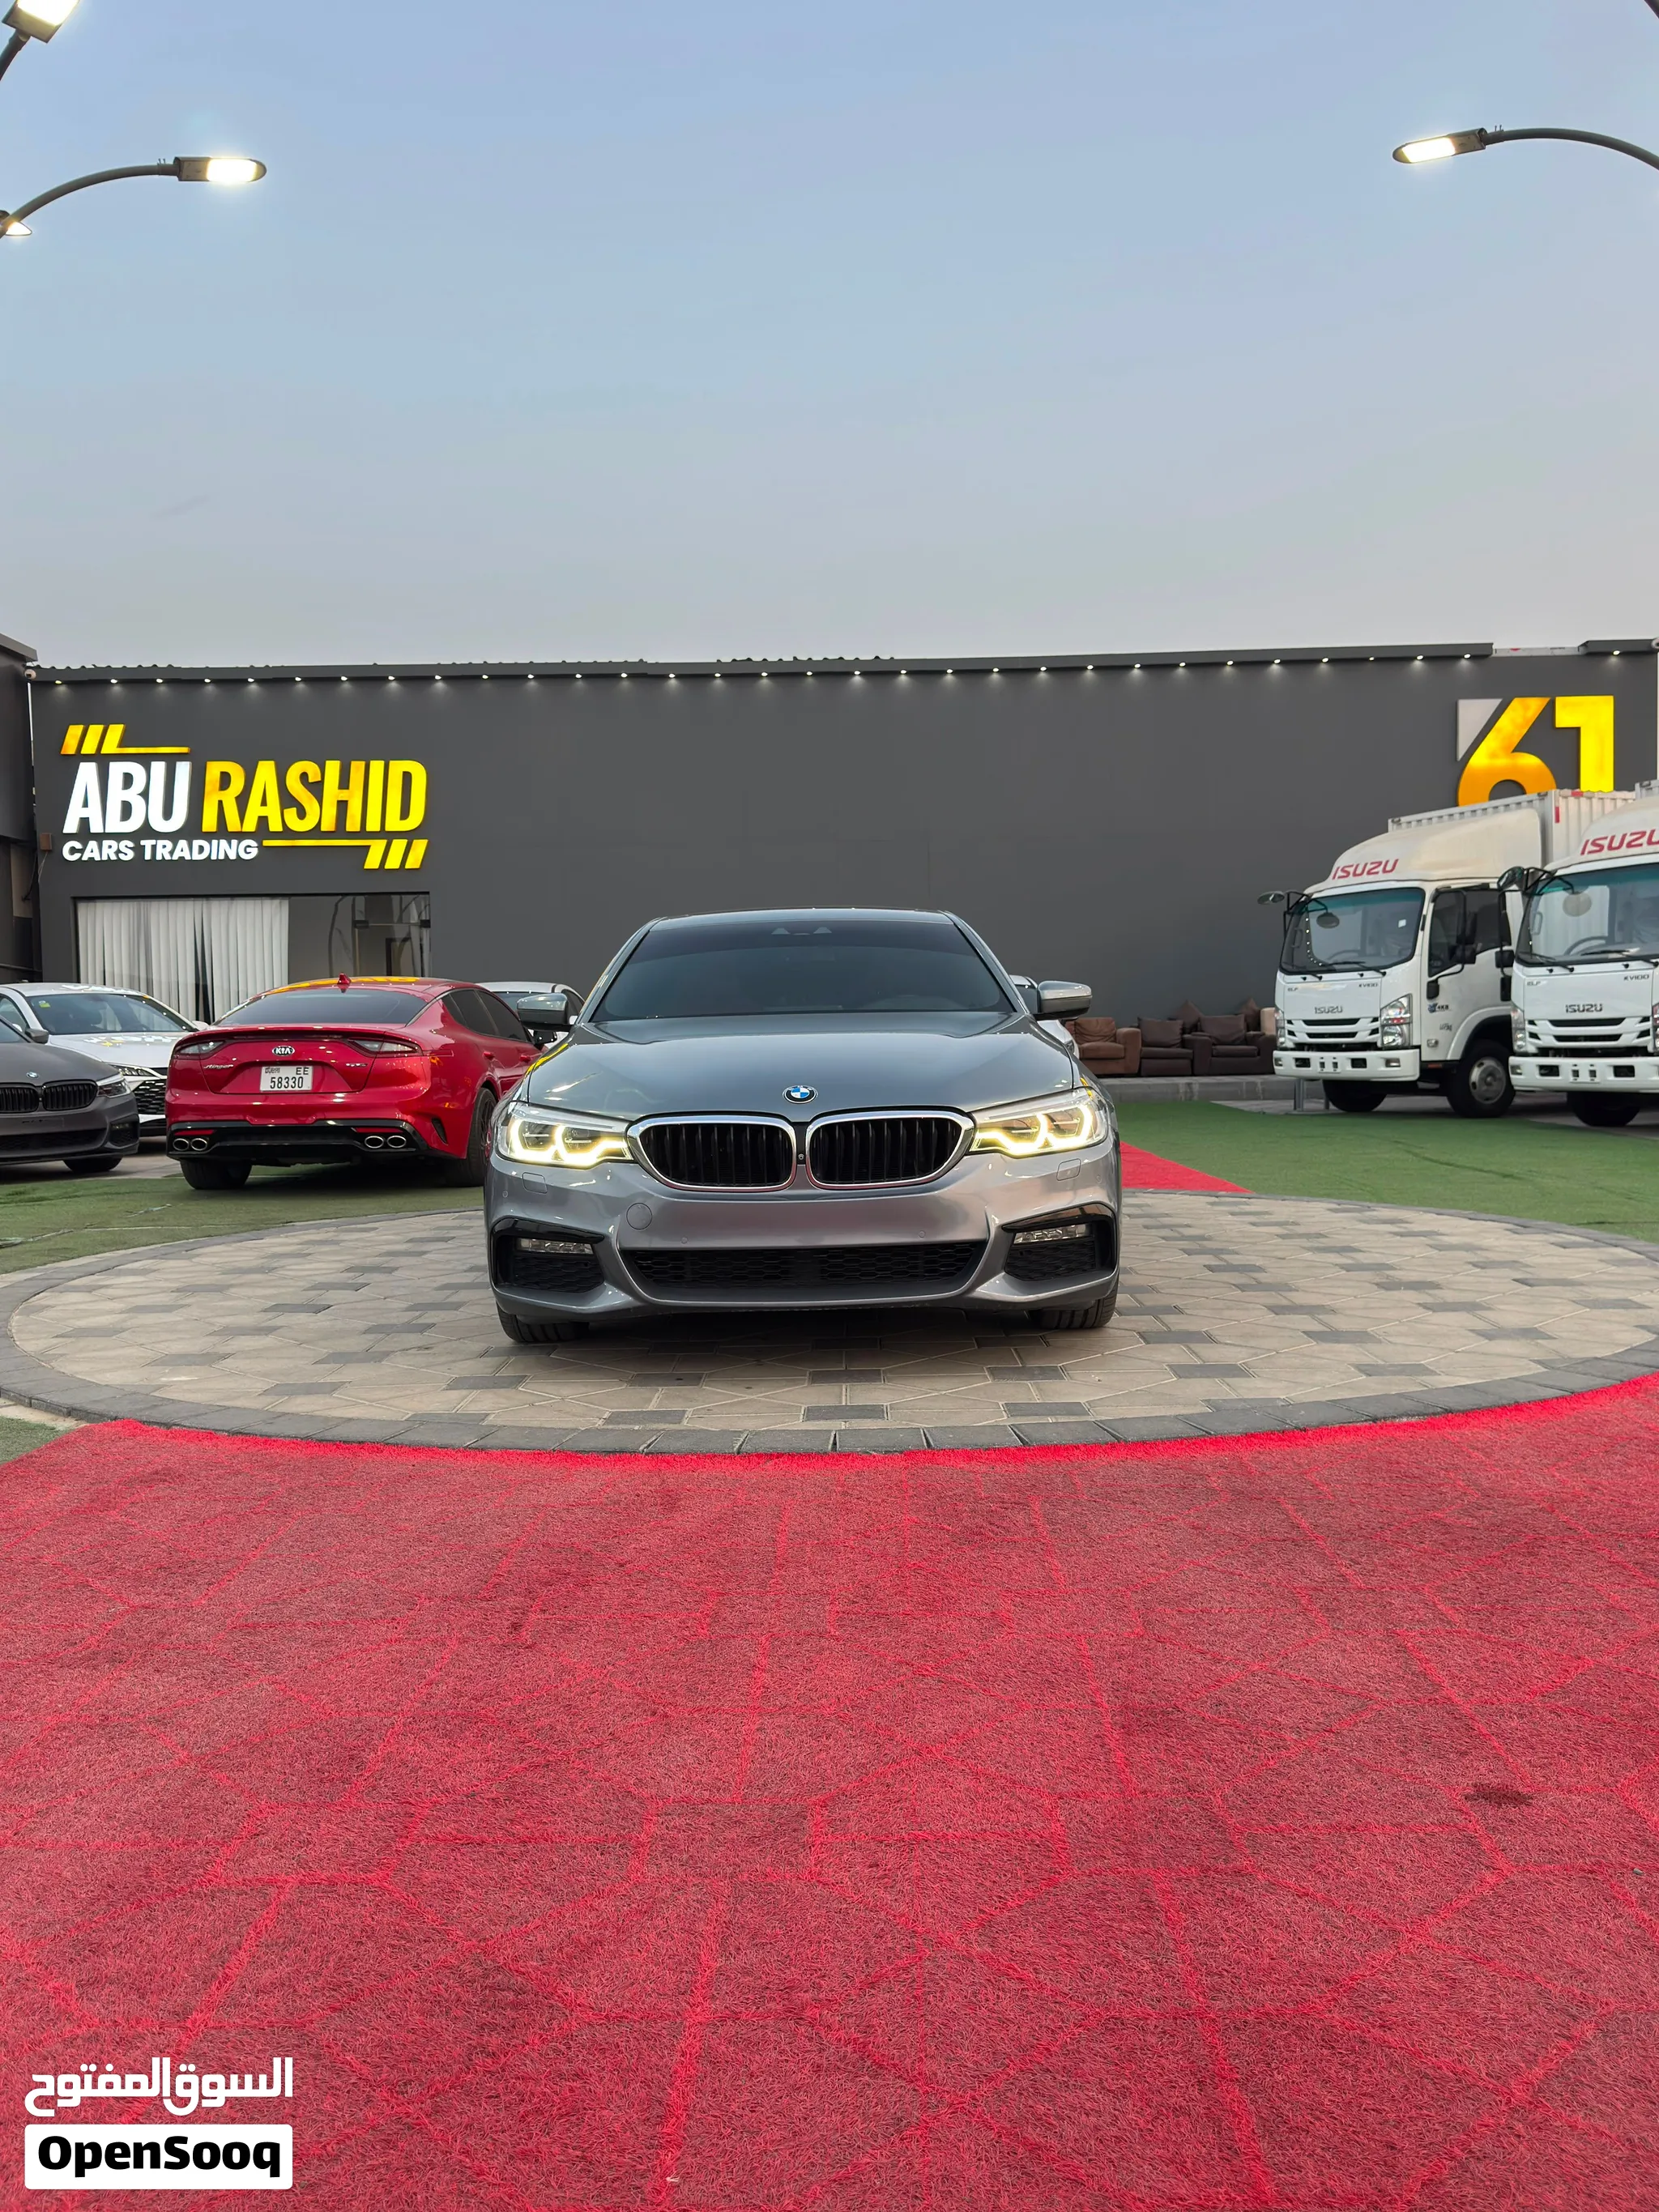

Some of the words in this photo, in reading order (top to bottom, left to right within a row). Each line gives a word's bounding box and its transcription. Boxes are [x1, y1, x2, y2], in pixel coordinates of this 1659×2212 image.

[1457, 695, 1614, 808] 61
[62, 761, 192, 833] ABU
[201, 761, 428, 833] RASHID
[62, 839, 134, 862] CARS
[140, 839, 258, 861] TRADING
[1331, 859, 1399, 880] ISUZU
[1314, 1005, 1343, 1014] ISUZU
[1565, 1004, 1603, 1013] ISUZU
[296, 1067, 309, 1076] EE
[270, 1076, 304, 1089] 58330
